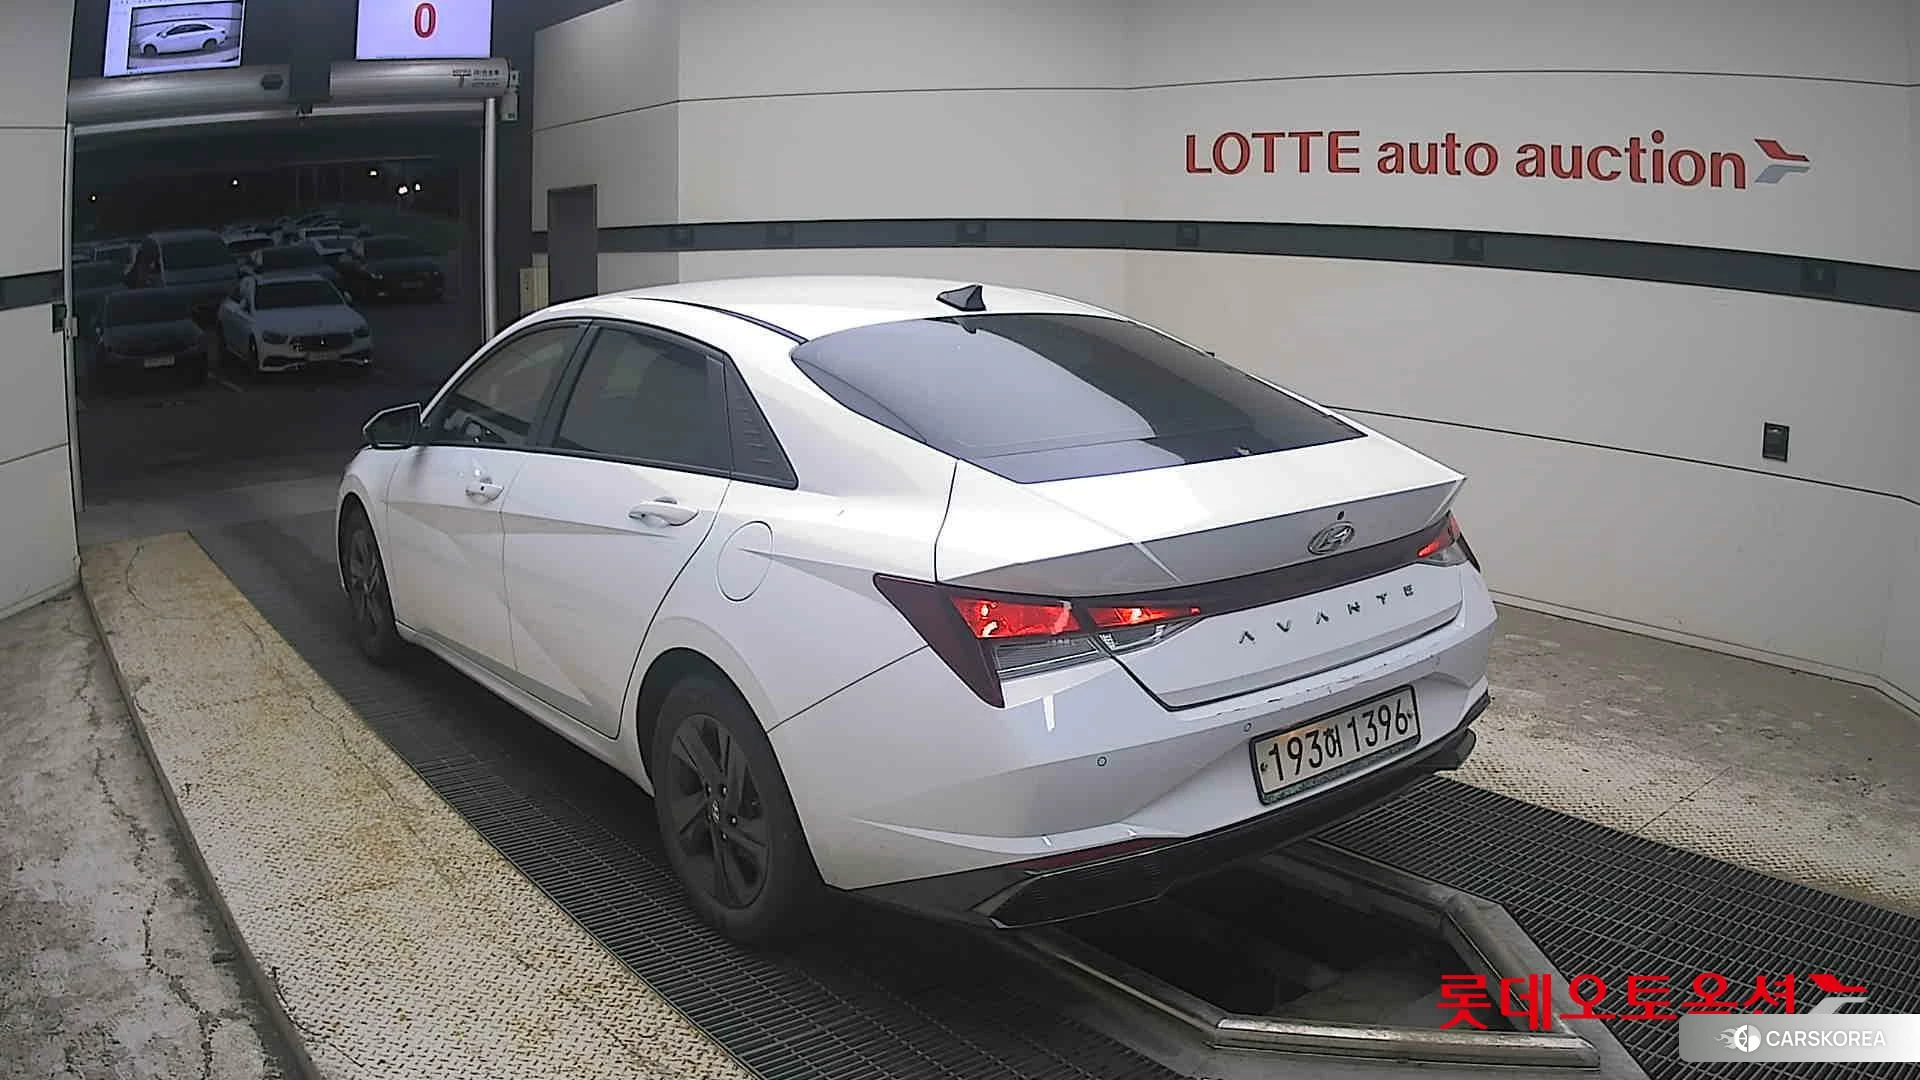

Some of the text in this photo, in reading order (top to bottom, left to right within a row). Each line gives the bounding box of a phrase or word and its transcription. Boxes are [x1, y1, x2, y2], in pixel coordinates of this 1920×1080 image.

[414, 3, 436, 38] 0
[1185, 129, 1747, 190] LOTTE auto auction
[1238, 583, 1415, 645] AVANTE
[1267, 698, 1409, 782] 193허 1396
